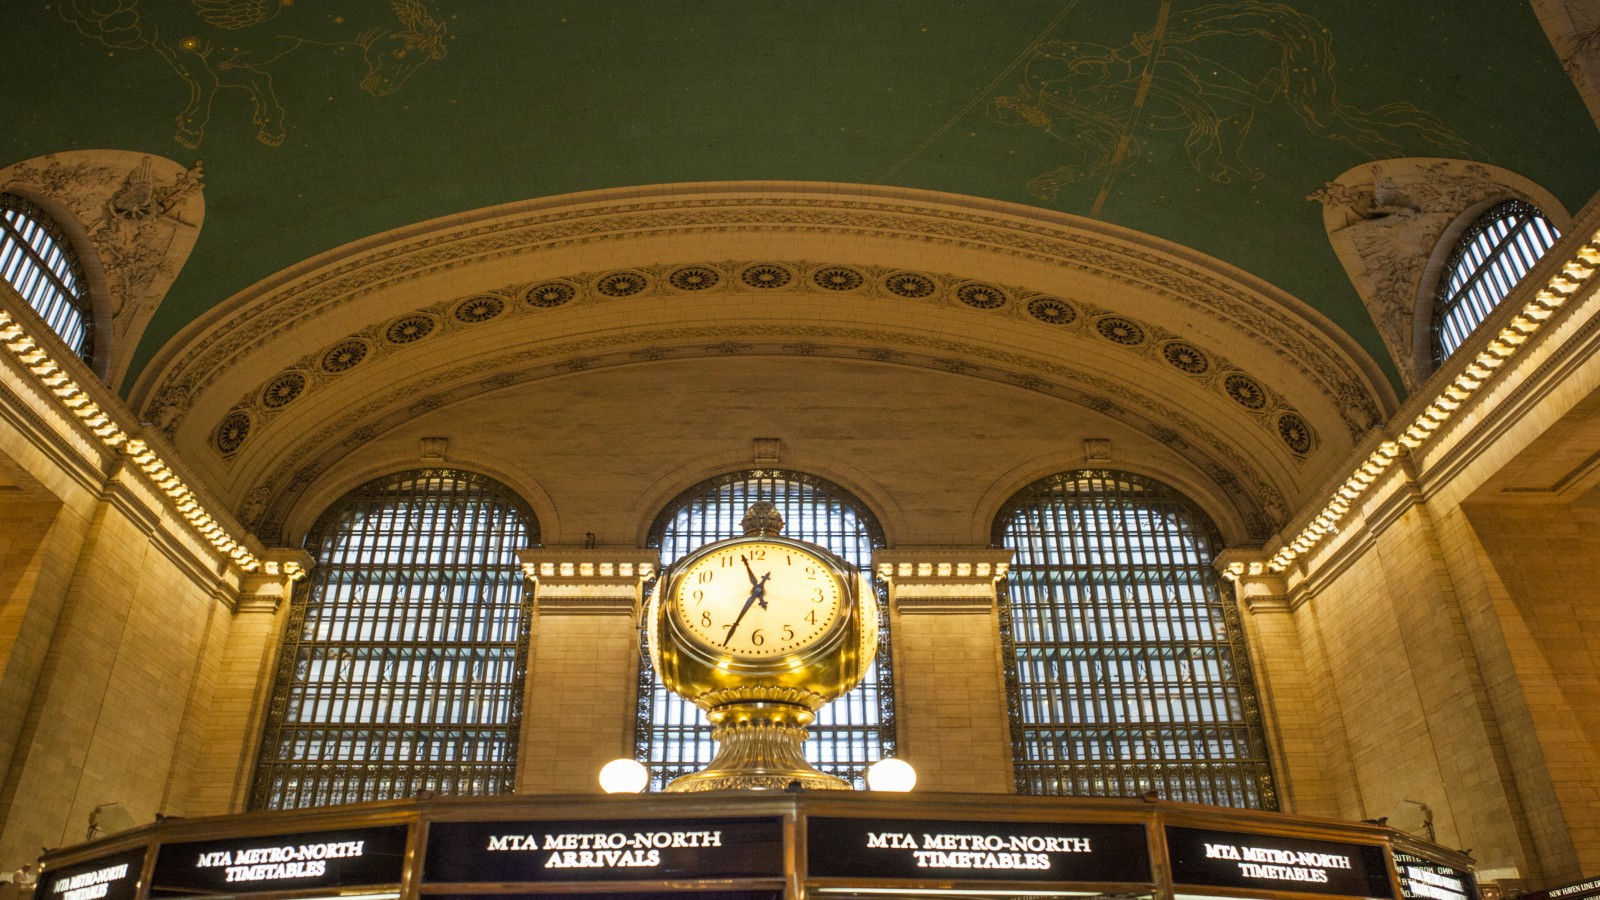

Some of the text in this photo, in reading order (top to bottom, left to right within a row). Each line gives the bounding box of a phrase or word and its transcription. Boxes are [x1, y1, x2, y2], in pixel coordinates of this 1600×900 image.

[721, 556, 733, 568] 11
[748, 549, 766, 561] 12
[786, 555, 791, 566] 1
[698, 569, 713, 584] 10
[805, 566, 817, 580] 2
[693, 590, 703, 605] 9
[811, 588, 824, 603] 3
[701, 611, 712, 628] 8
[804, 609, 817, 625] 4
[751, 629, 765, 646] 6
[780, 625, 794, 641] 5
[488, 831, 722, 850] MTA METRO-NORTH
[867, 832, 1092, 853] MTA METRO-NORTH
[196, 840, 364, 868] MTA METRO-NORTH
[545, 850, 660, 868] ARRIVALS
[913, 851, 1051, 869] TIMETABLES
[1205, 843, 1352, 869] MTA METRO-NORTH
[225, 860, 326, 883] TIMETABLES
[1238, 862, 1328, 883] TIMETABLES
[1548, 889, 1561, 898] NEW
[1561, 885, 1581, 895] HAVEN
[1580, 882, 1594, 891] LINE
